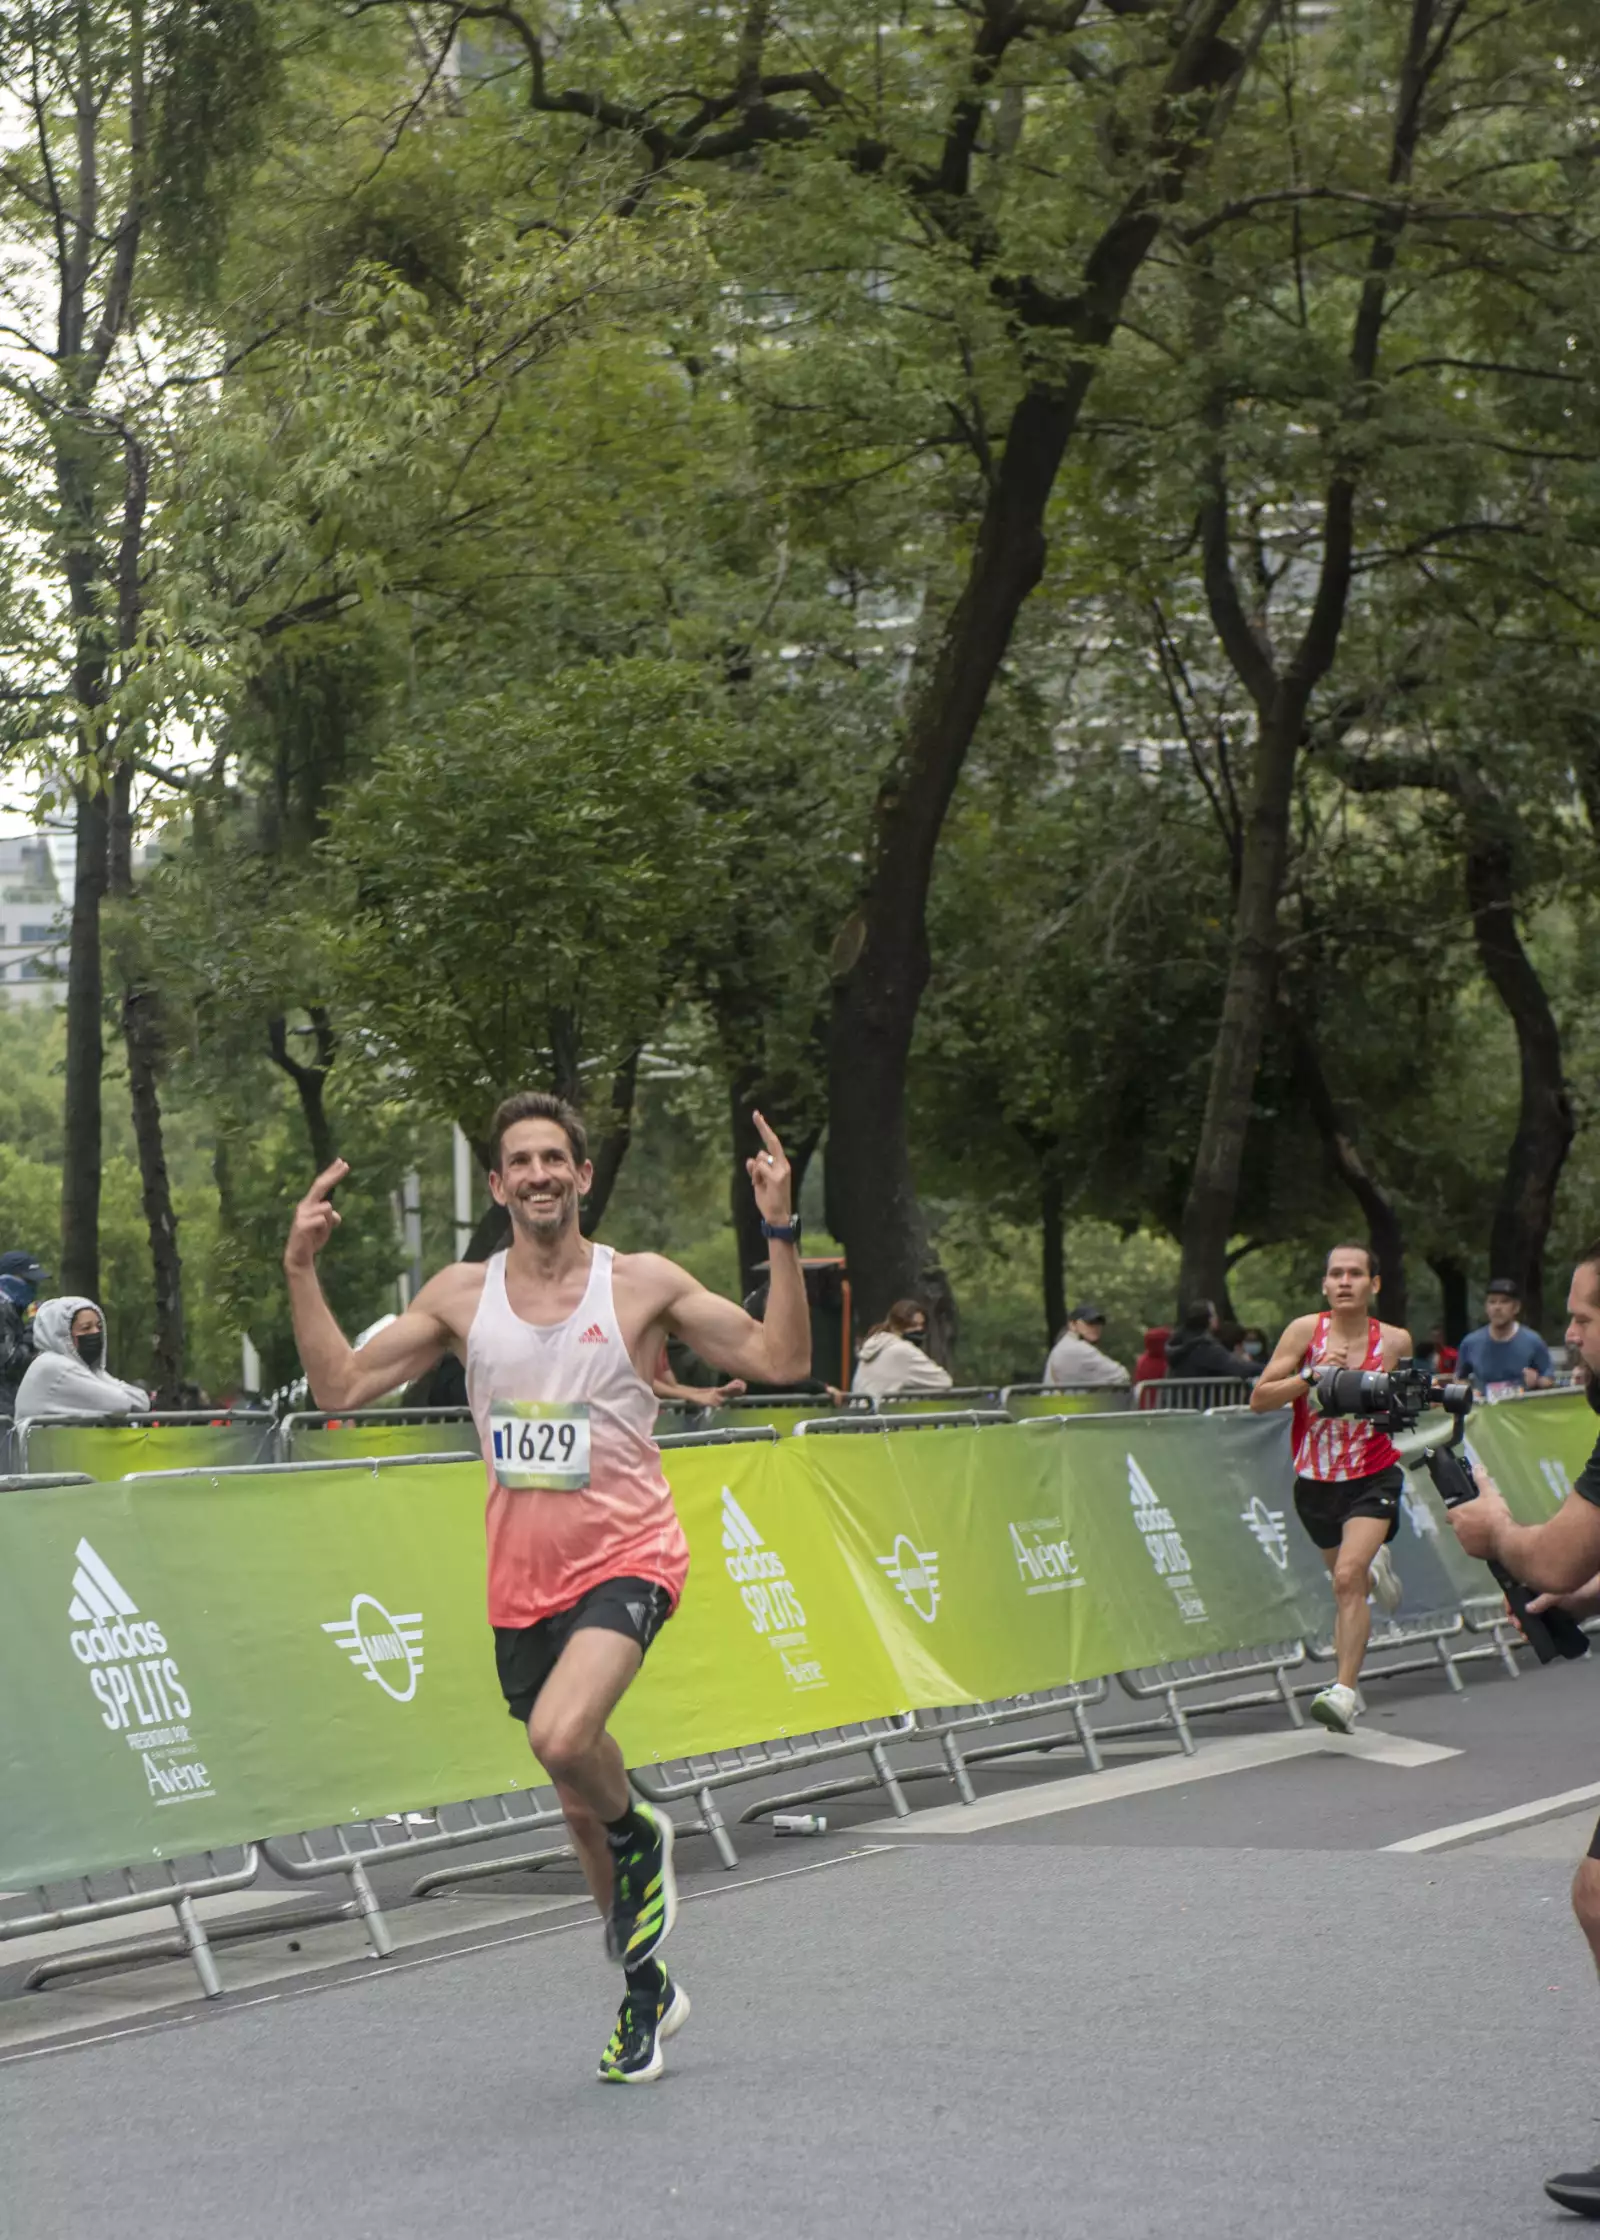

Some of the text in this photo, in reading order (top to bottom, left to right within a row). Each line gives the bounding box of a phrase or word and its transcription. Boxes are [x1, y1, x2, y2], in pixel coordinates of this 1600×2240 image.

[503, 1422, 576, 1462] 1629
[741, 1580, 807, 1634] SPLITS
[70, 1615, 168, 1664] adidas
[90, 1658, 192, 1730] SPLITS
[142, 1753, 212, 1796] Avène
